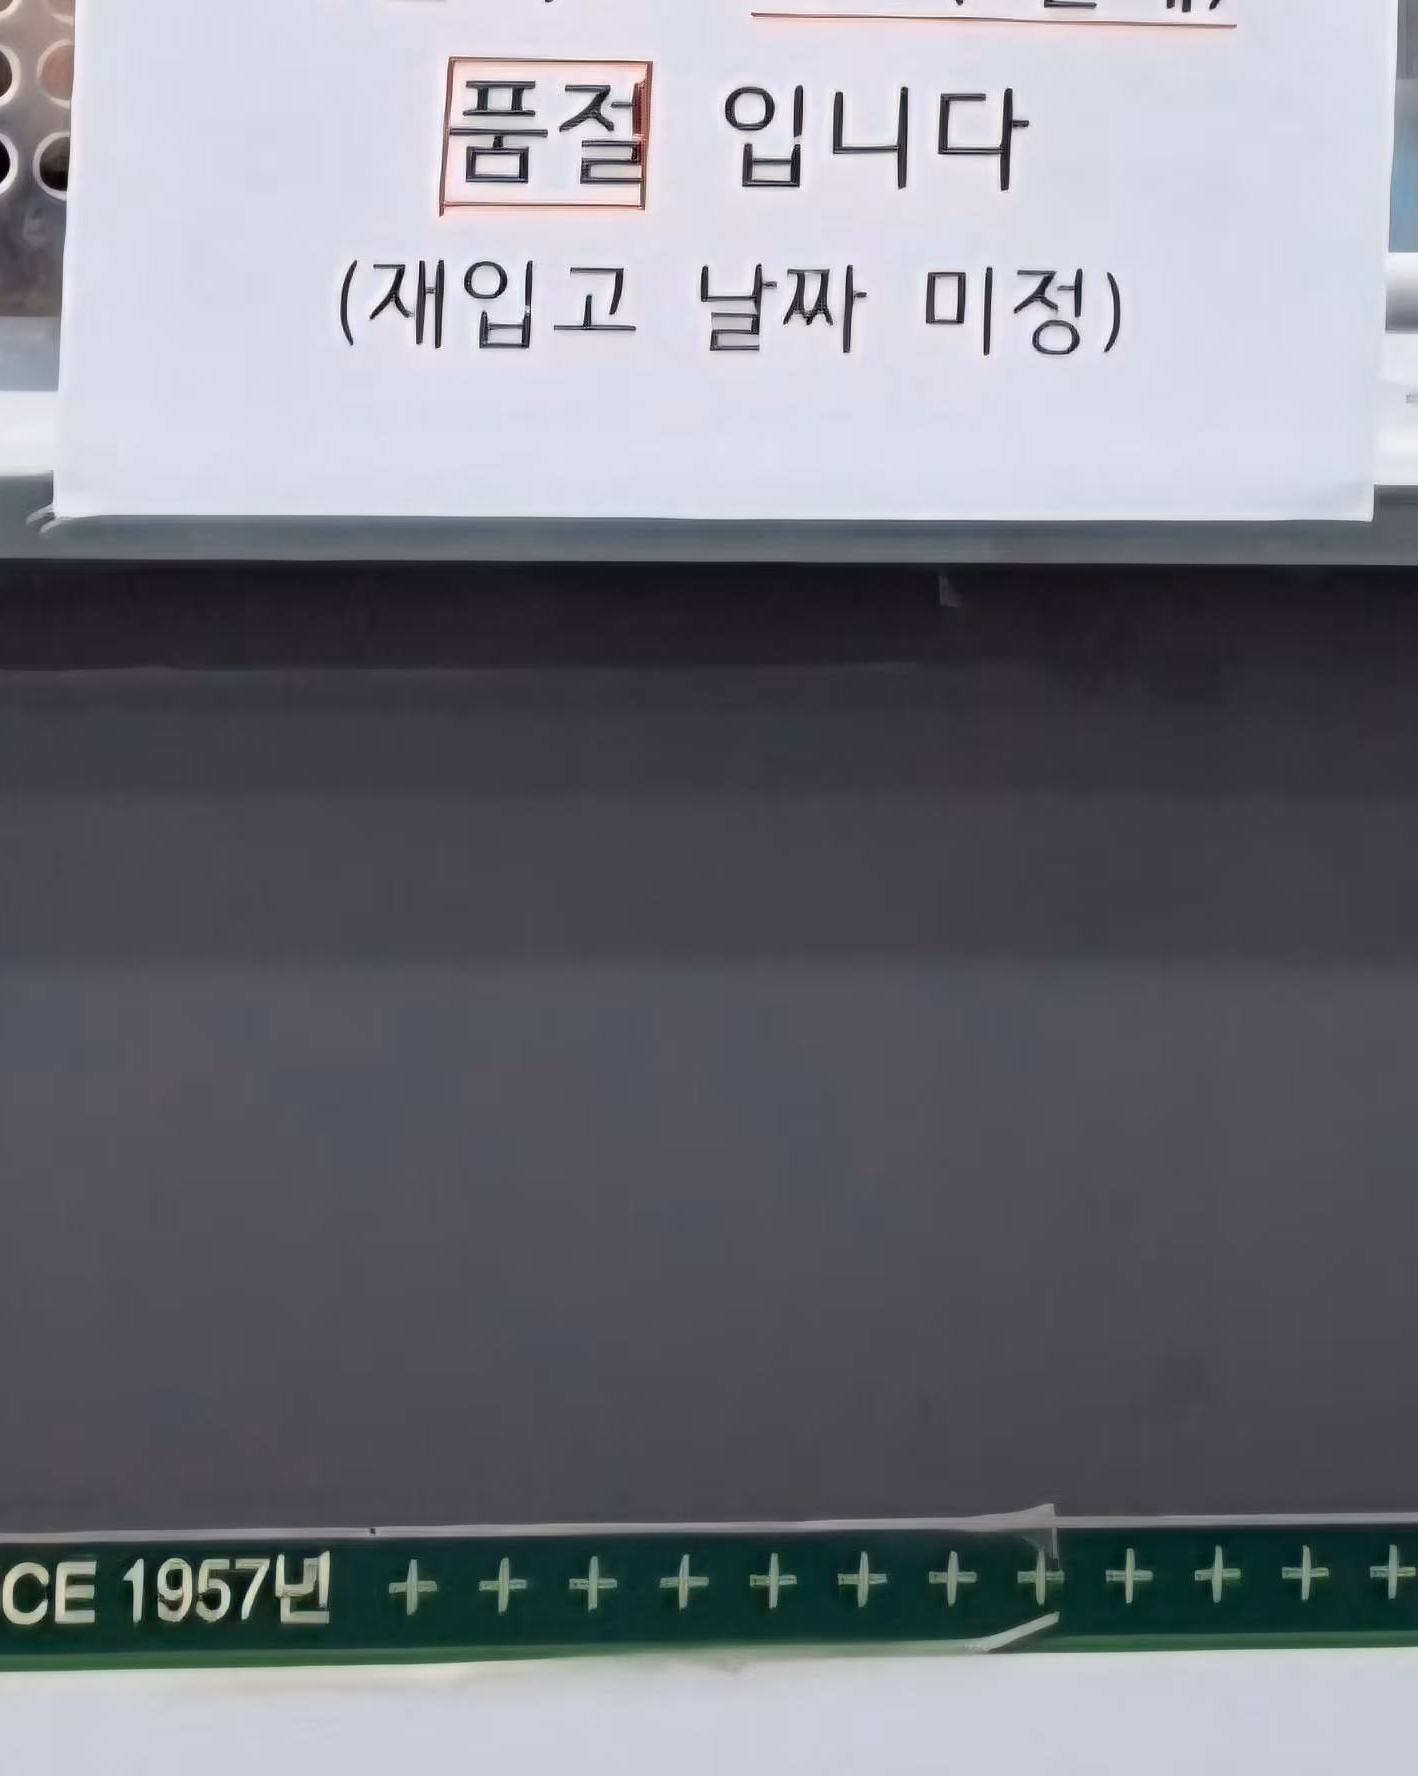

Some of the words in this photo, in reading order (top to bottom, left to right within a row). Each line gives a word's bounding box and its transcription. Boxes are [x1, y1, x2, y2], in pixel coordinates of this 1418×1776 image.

[450, 79, 644, 186] 품절
[724, 84, 1031, 192] 입니다
[339, 259, 638, 351] (재입고
[699, 262, 868, 354] 날짜
[925, 266, 1122, 357] 미정)
[121, 1550, 331, 1625] 1957년
